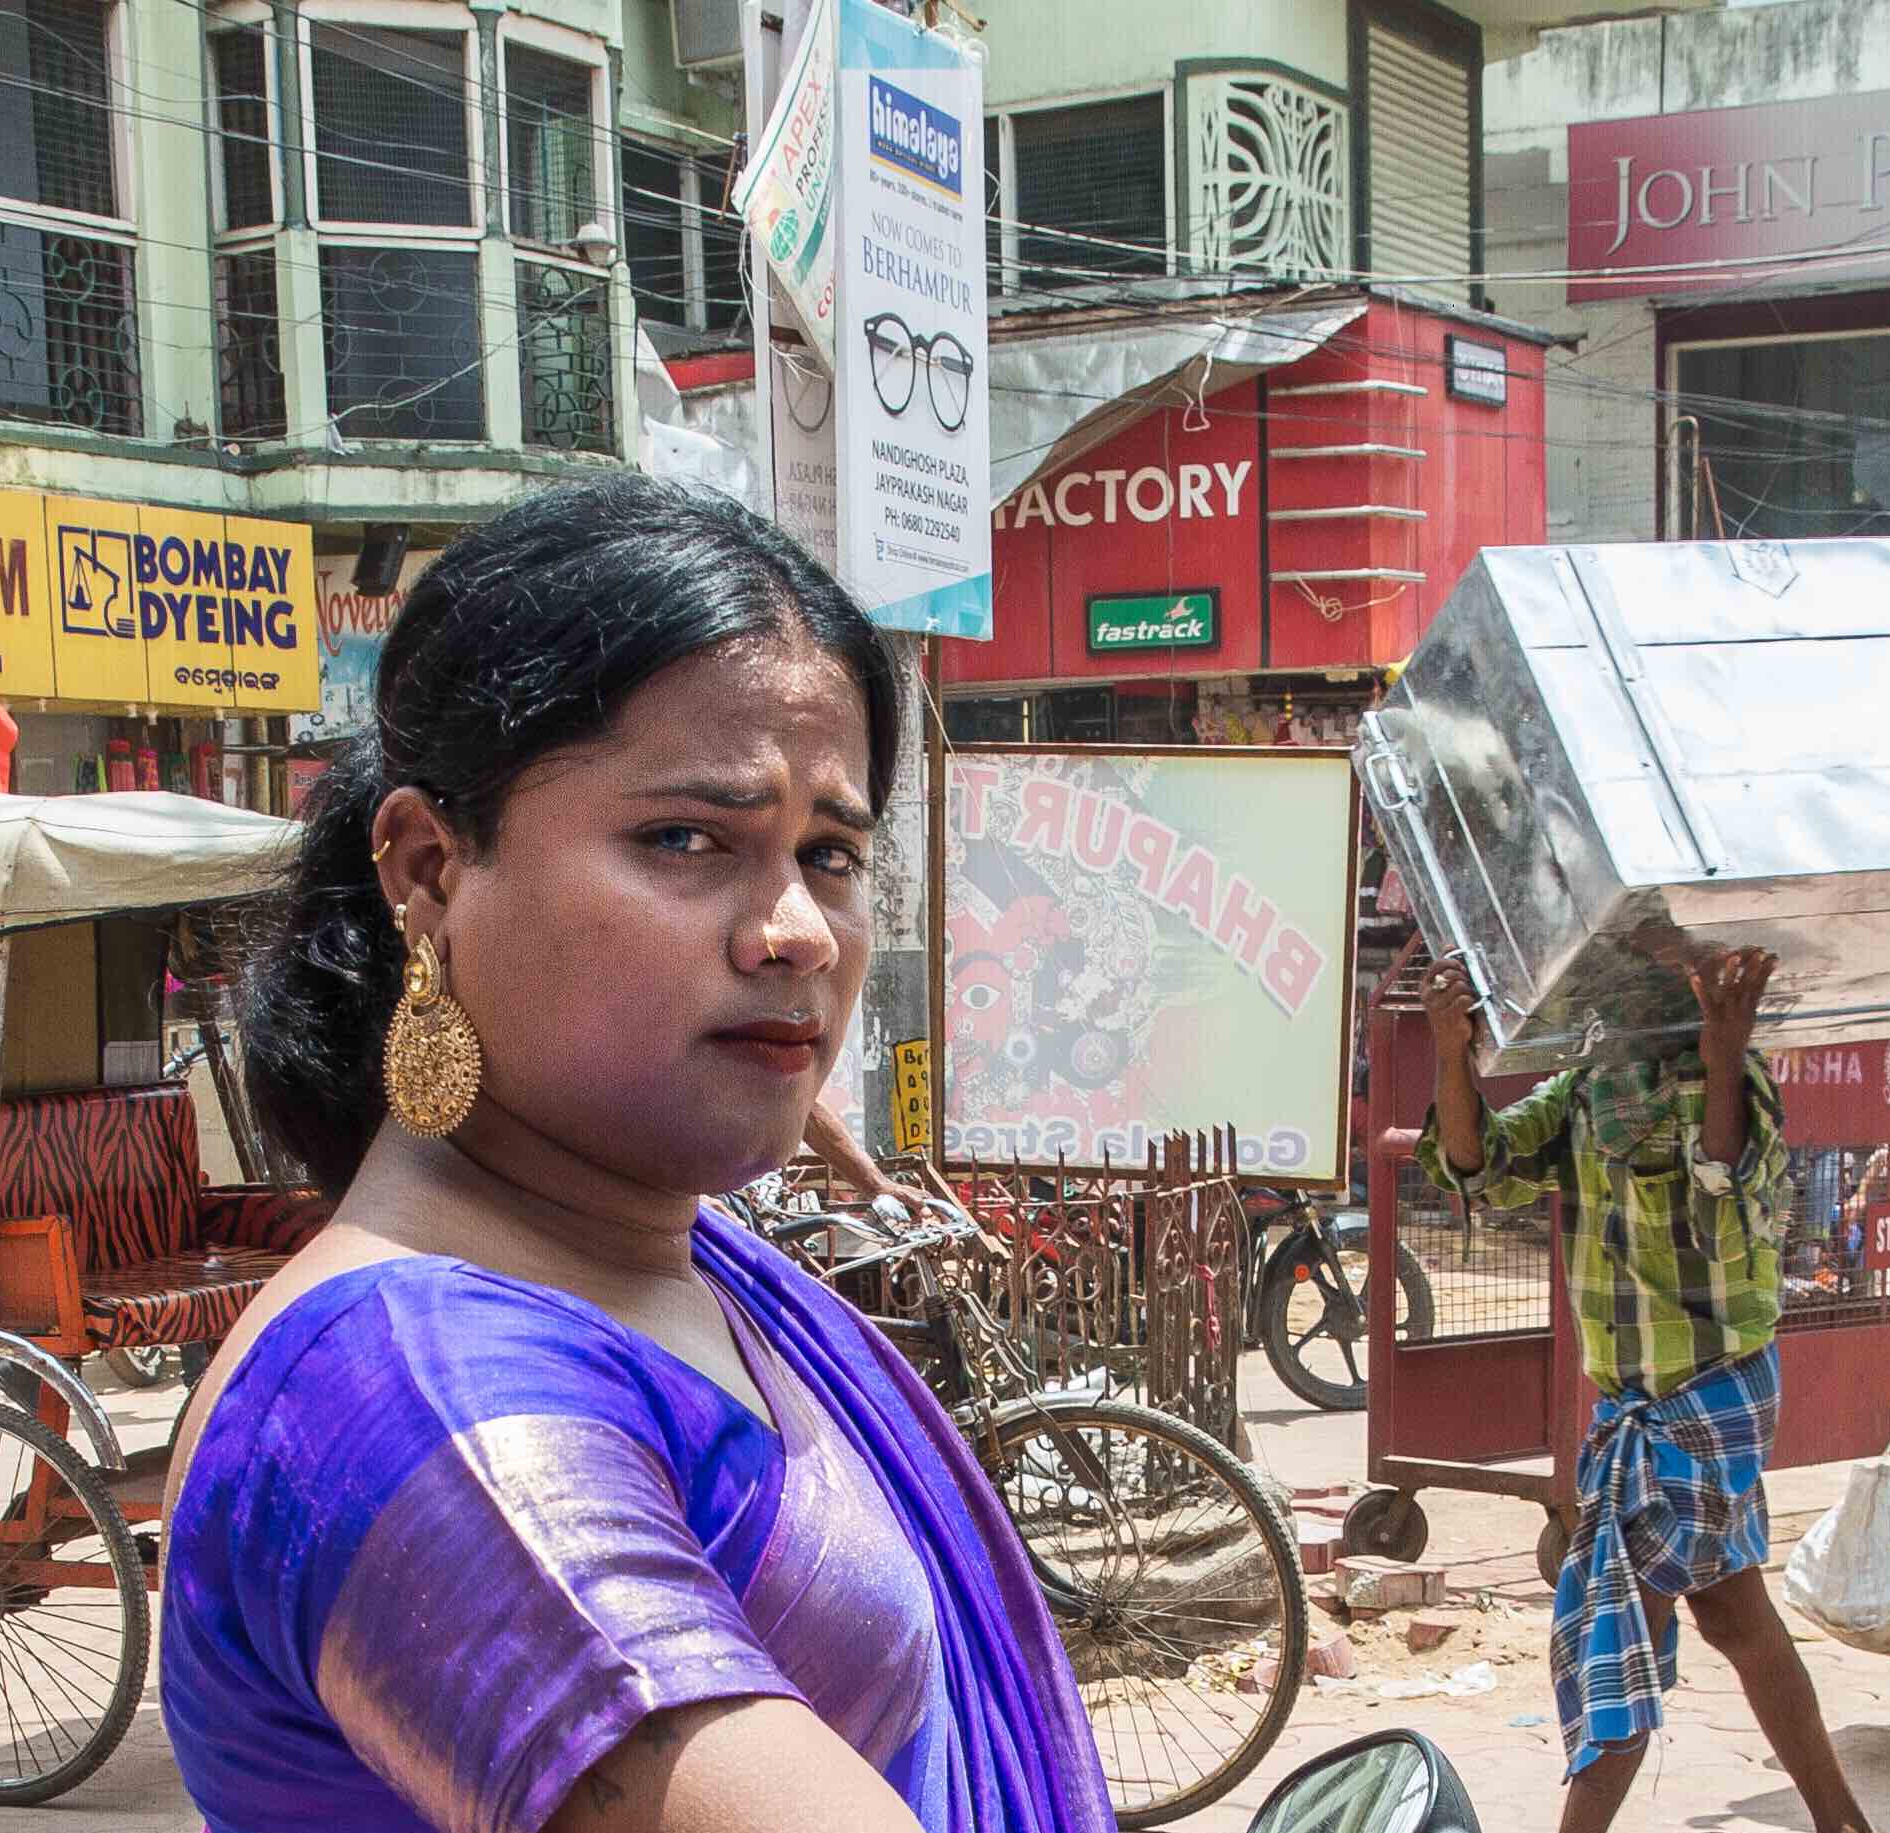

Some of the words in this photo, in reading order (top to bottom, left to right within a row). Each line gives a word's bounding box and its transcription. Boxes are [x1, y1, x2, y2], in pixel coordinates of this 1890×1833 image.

[872, 86, 959, 179] himalaya
[1606, 155, 1819, 256] JOHN
[871, 208, 902, 244] NOW
[905, 225, 944, 262] COMES
[948, 241, 962, 268] TO
[862, 235, 973, 314] BERHAMPUR
[872, 440, 937, 476] NANDIGHOSH
[874, 472, 935, 505] JAYPRAKASH
[937, 490, 968, 516] NAGAR
[885, 506, 900, 528] PH:
[902, 512, 923, 534] 0680
[134, 534, 291, 594] BOMBAY
[138, 590, 297, 649] DYEING
[1096, 618, 1205, 642] fastrack
